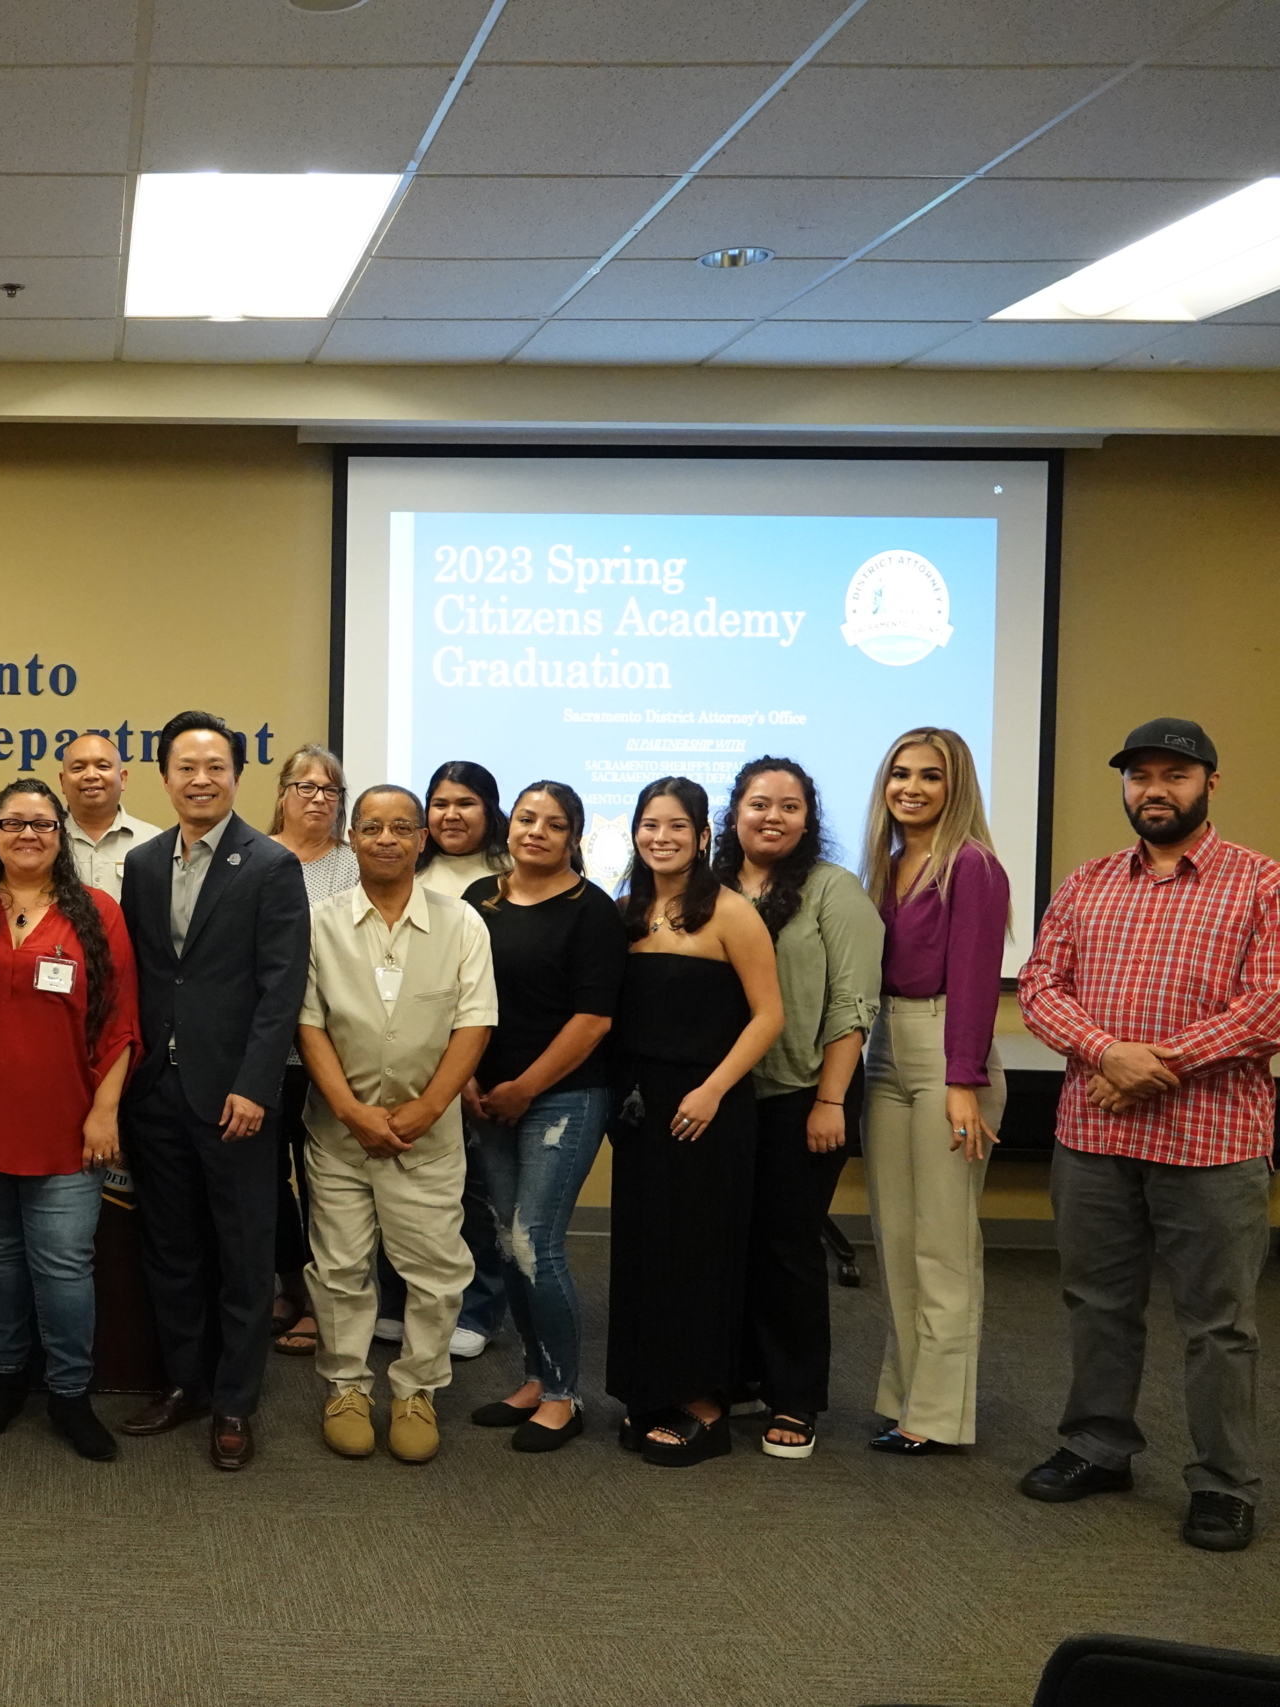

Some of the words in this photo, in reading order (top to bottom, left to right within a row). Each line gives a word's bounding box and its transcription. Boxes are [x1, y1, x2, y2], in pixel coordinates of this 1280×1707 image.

[434, 545, 533, 584] 2023
[547, 544, 687, 594] Spring
[852, 556, 892, 600] DISTRICT
[898, 556, 943, 602] ATTORNEY
[434, 594, 603, 637] Citizens
[615, 597, 805, 647] Academy
[433, 646, 672, 690] Graduation
[563, 708, 641, 723] Sacramento
[645, 709, 695, 724] District
[698, 710, 765, 726] Attorney's
[769, 711, 807, 725] Office
[585, 760, 659, 771] SACRAMENTO
[626, 739, 640, 751] IN
[640, 739, 715, 751] PARTNERSHIP
[715, 740, 746, 752] WITH
